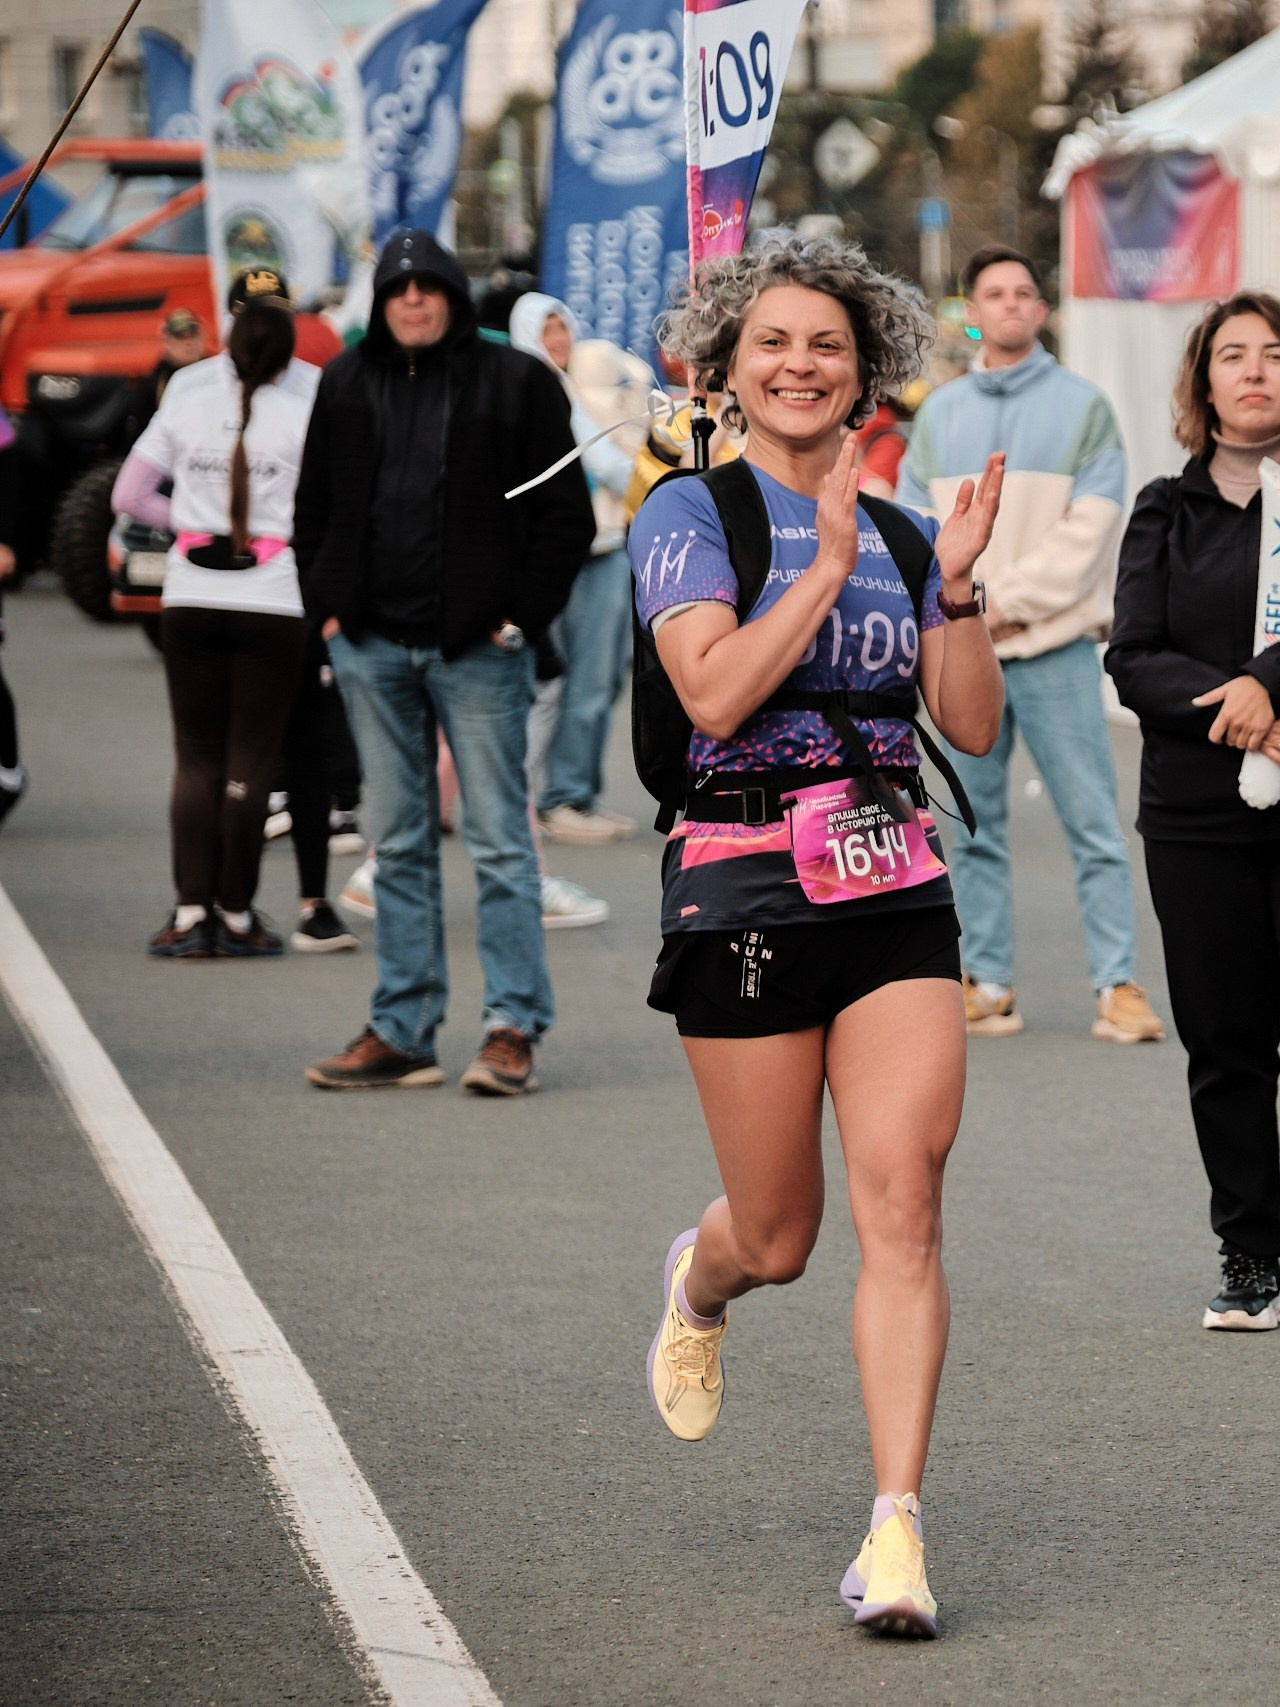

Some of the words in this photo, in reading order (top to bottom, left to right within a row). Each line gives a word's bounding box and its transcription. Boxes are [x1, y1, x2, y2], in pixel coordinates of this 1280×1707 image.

[770, 523, 819, 540] ASIC
[797, 607, 919, 678] 1:09
[827, 808, 860, 823] ВПИШИ
[860, 804, 881, 816] СВОЕ
[827, 825, 835, 834] В
[836, 816, 876, 832] ИСТОРИЮ
[877, 813, 896, 823] ГОР
[825, 825, 912, 881] 1644
[870, 875, 881, 886] 10
